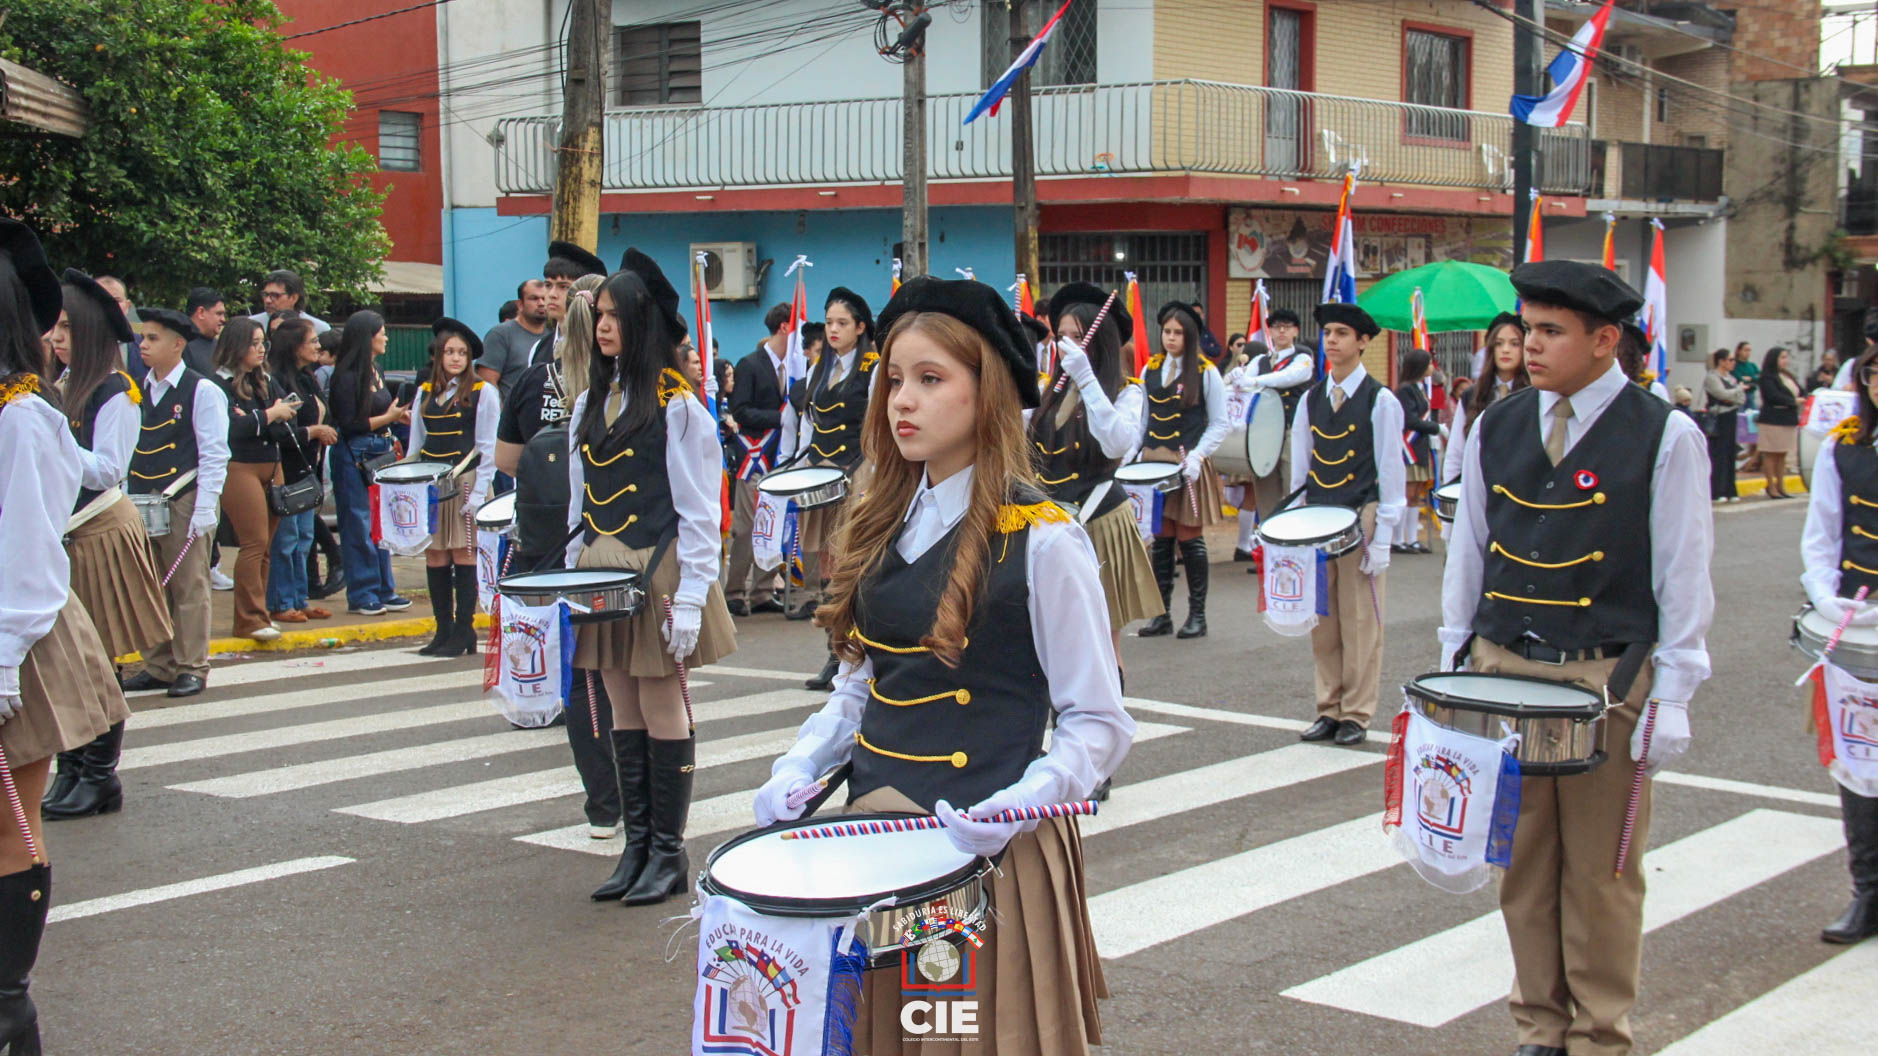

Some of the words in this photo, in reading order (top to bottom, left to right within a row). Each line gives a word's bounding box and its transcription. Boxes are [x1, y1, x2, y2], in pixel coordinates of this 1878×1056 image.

[1369, 215, 1447, 234] CONFECCIONES
[739, 927, 769, 948] PARA
[770, 939, 784, 956] LA
[784, 947, 810, 977] VIDA
